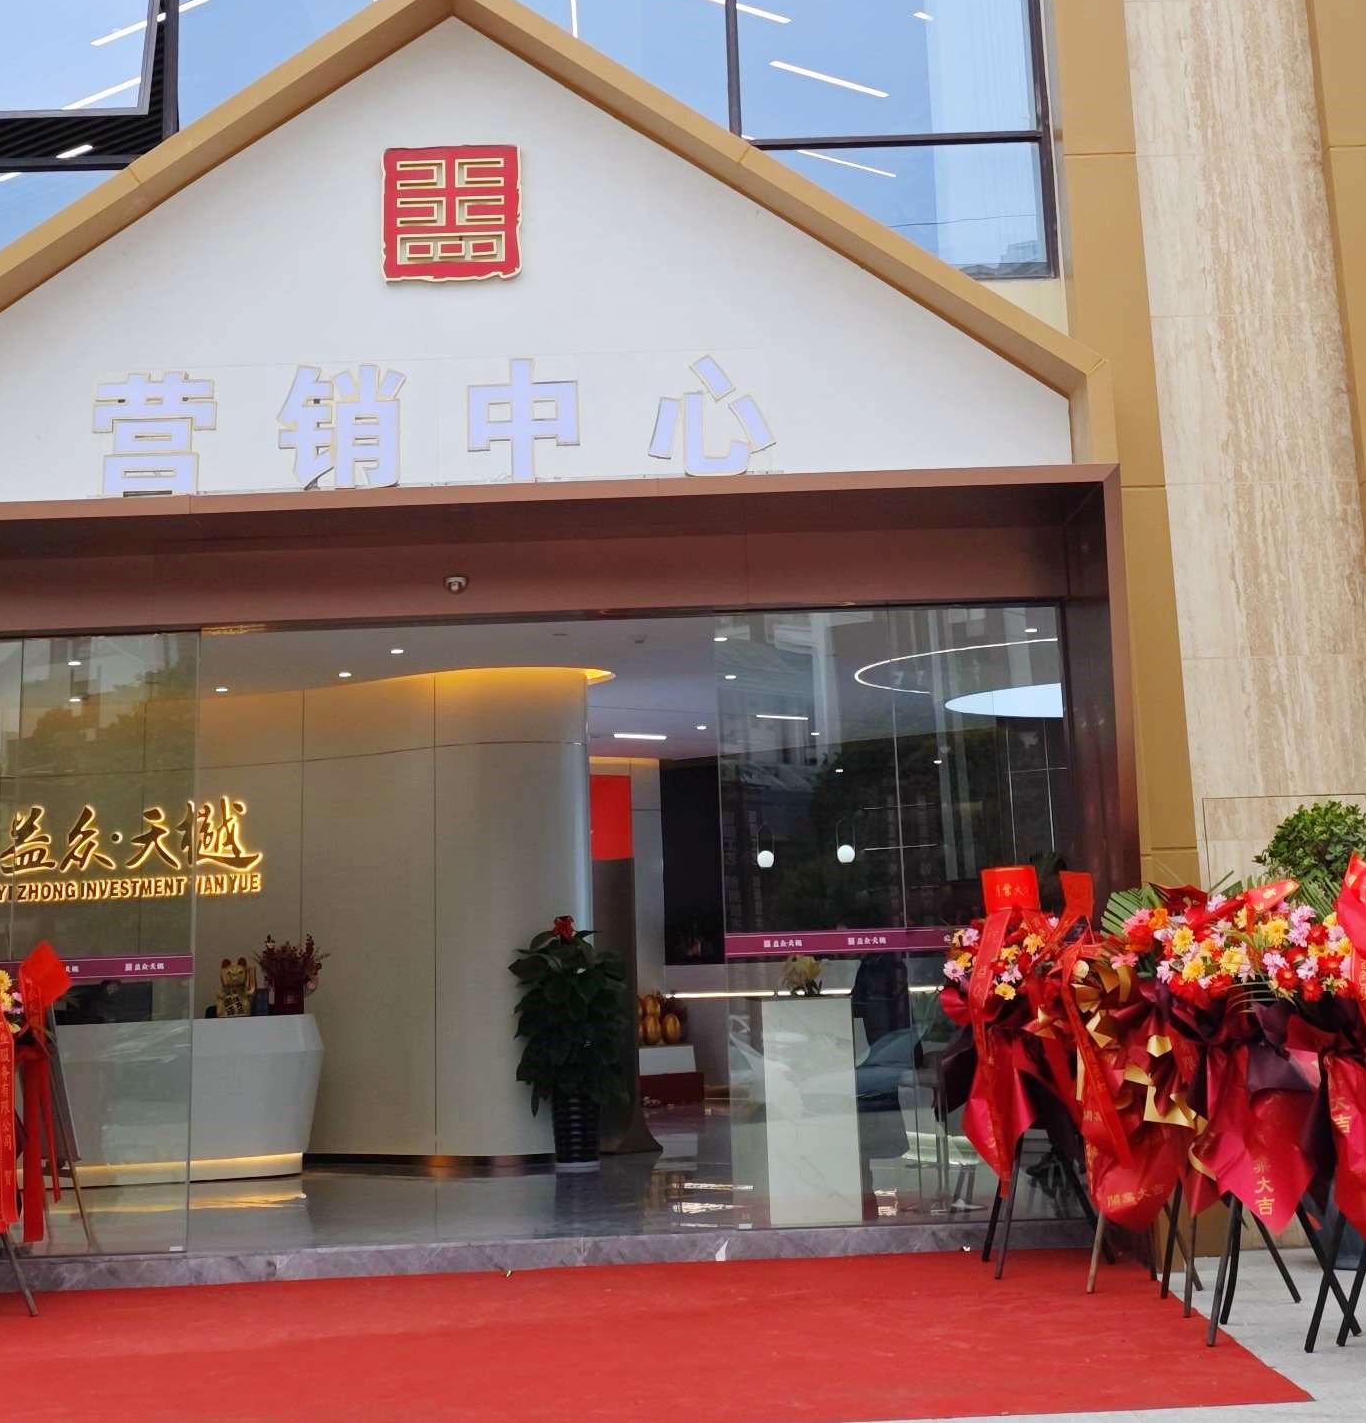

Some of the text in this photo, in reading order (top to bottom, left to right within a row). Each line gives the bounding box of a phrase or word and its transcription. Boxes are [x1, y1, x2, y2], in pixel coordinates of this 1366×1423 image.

[92, 355, 777, 496] 营销中心
[18, 881, 76, 902] ZHONG
[80, 876, 187, 901] INVESTMENT
